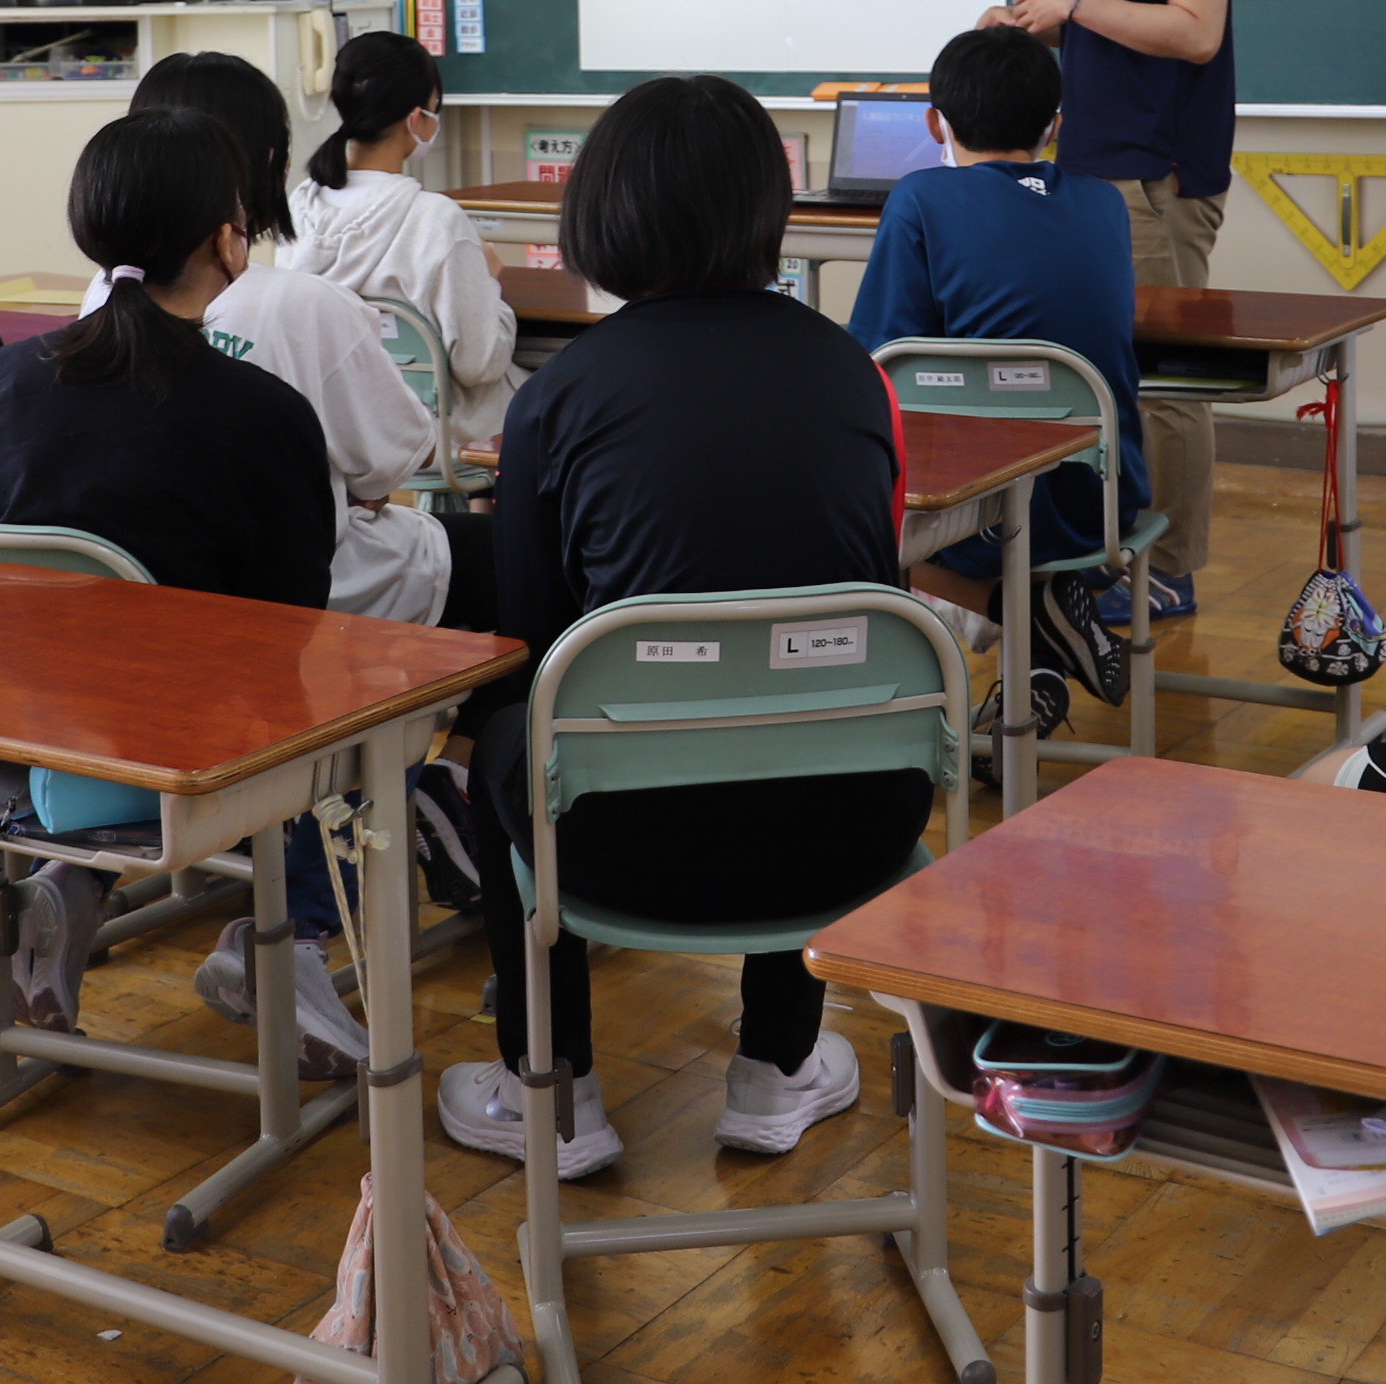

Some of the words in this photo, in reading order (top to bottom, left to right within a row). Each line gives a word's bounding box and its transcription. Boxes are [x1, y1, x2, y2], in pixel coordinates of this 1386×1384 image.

[999, 370, 1008, 382] L
[646, 644, 674, 658] 原田
[695, 644, 710, 658] 希
[787, 637, 800, 654] L
